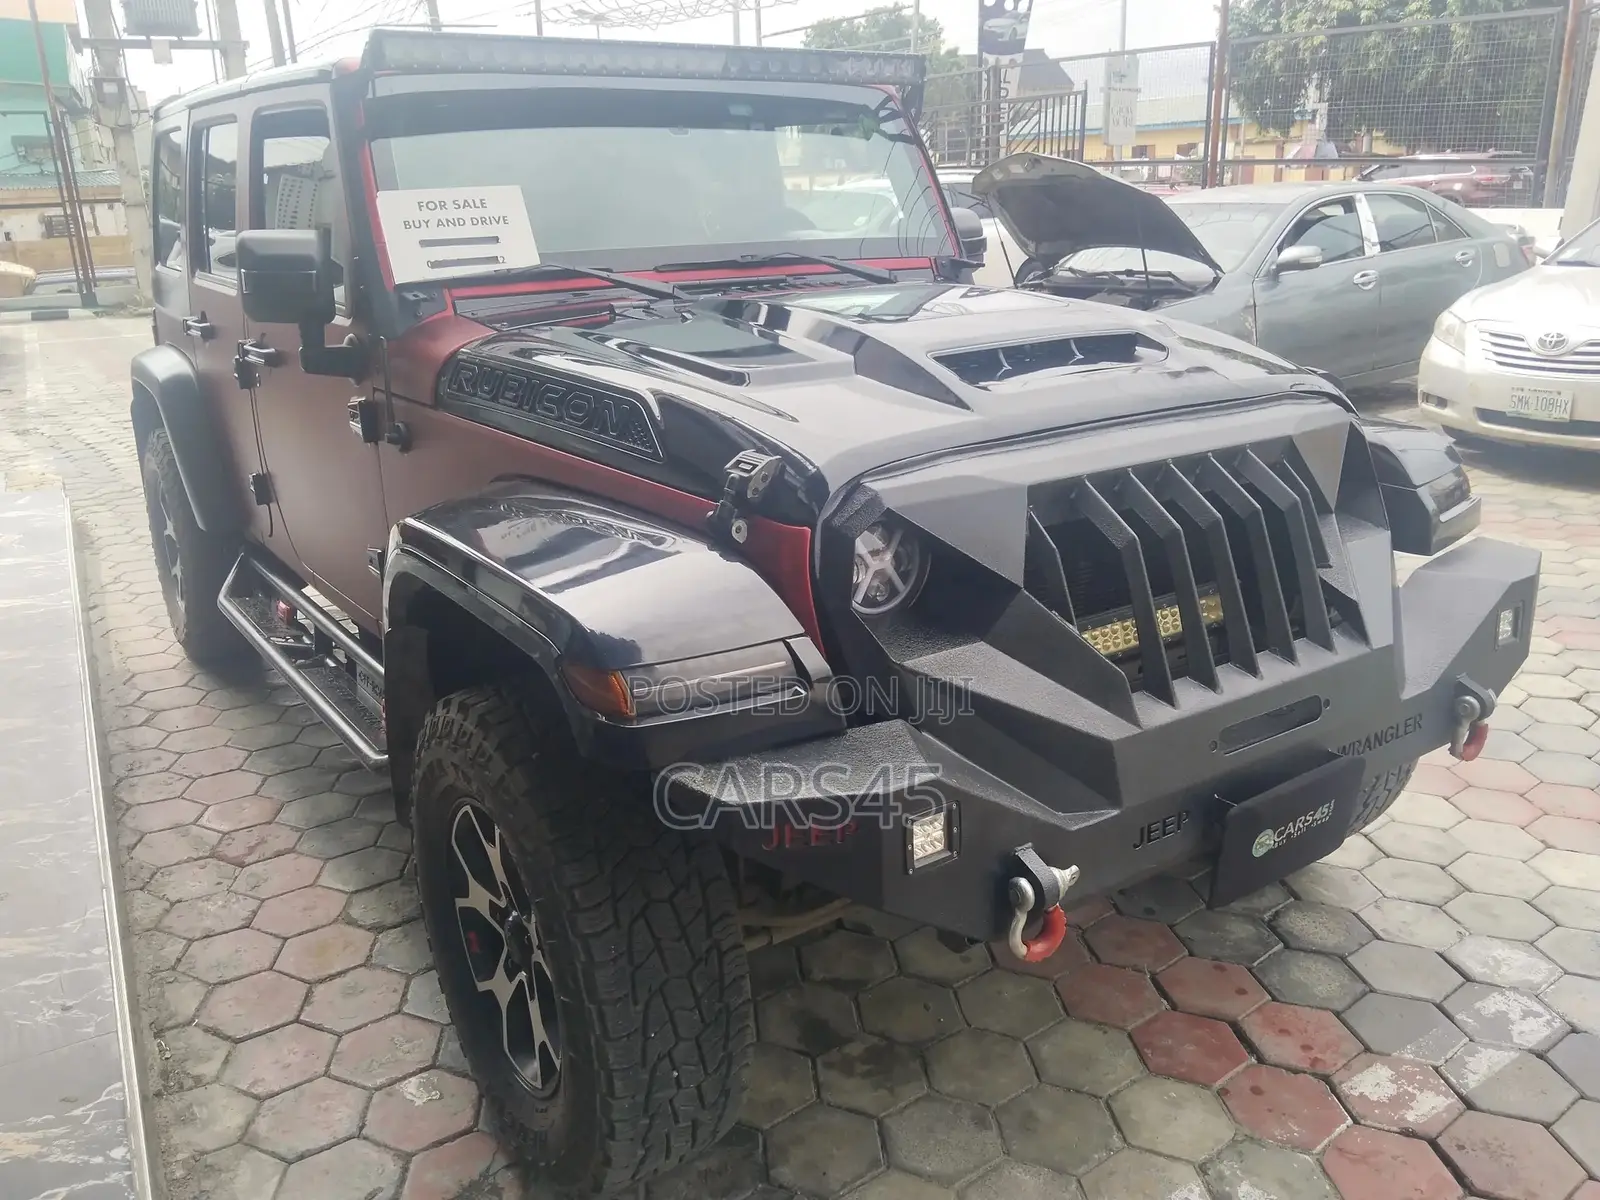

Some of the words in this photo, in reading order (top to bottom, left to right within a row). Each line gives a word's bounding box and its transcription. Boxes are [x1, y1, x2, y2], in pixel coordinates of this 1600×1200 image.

[403, 218, 431, 230] BUY
[436, 216, 466, 228] AND
[470, 215, 509, 227] DRIVE
[417, 199, 448, 212] FOR
[452, 198, 488, 210] SALE
[450, 361, 630, 436] RUBICON
[1336, 713, 1422, 756] WRANGLER
[762, 820, 858, 850] JEEP
[1133, 810, 1190, 850] JEEP
